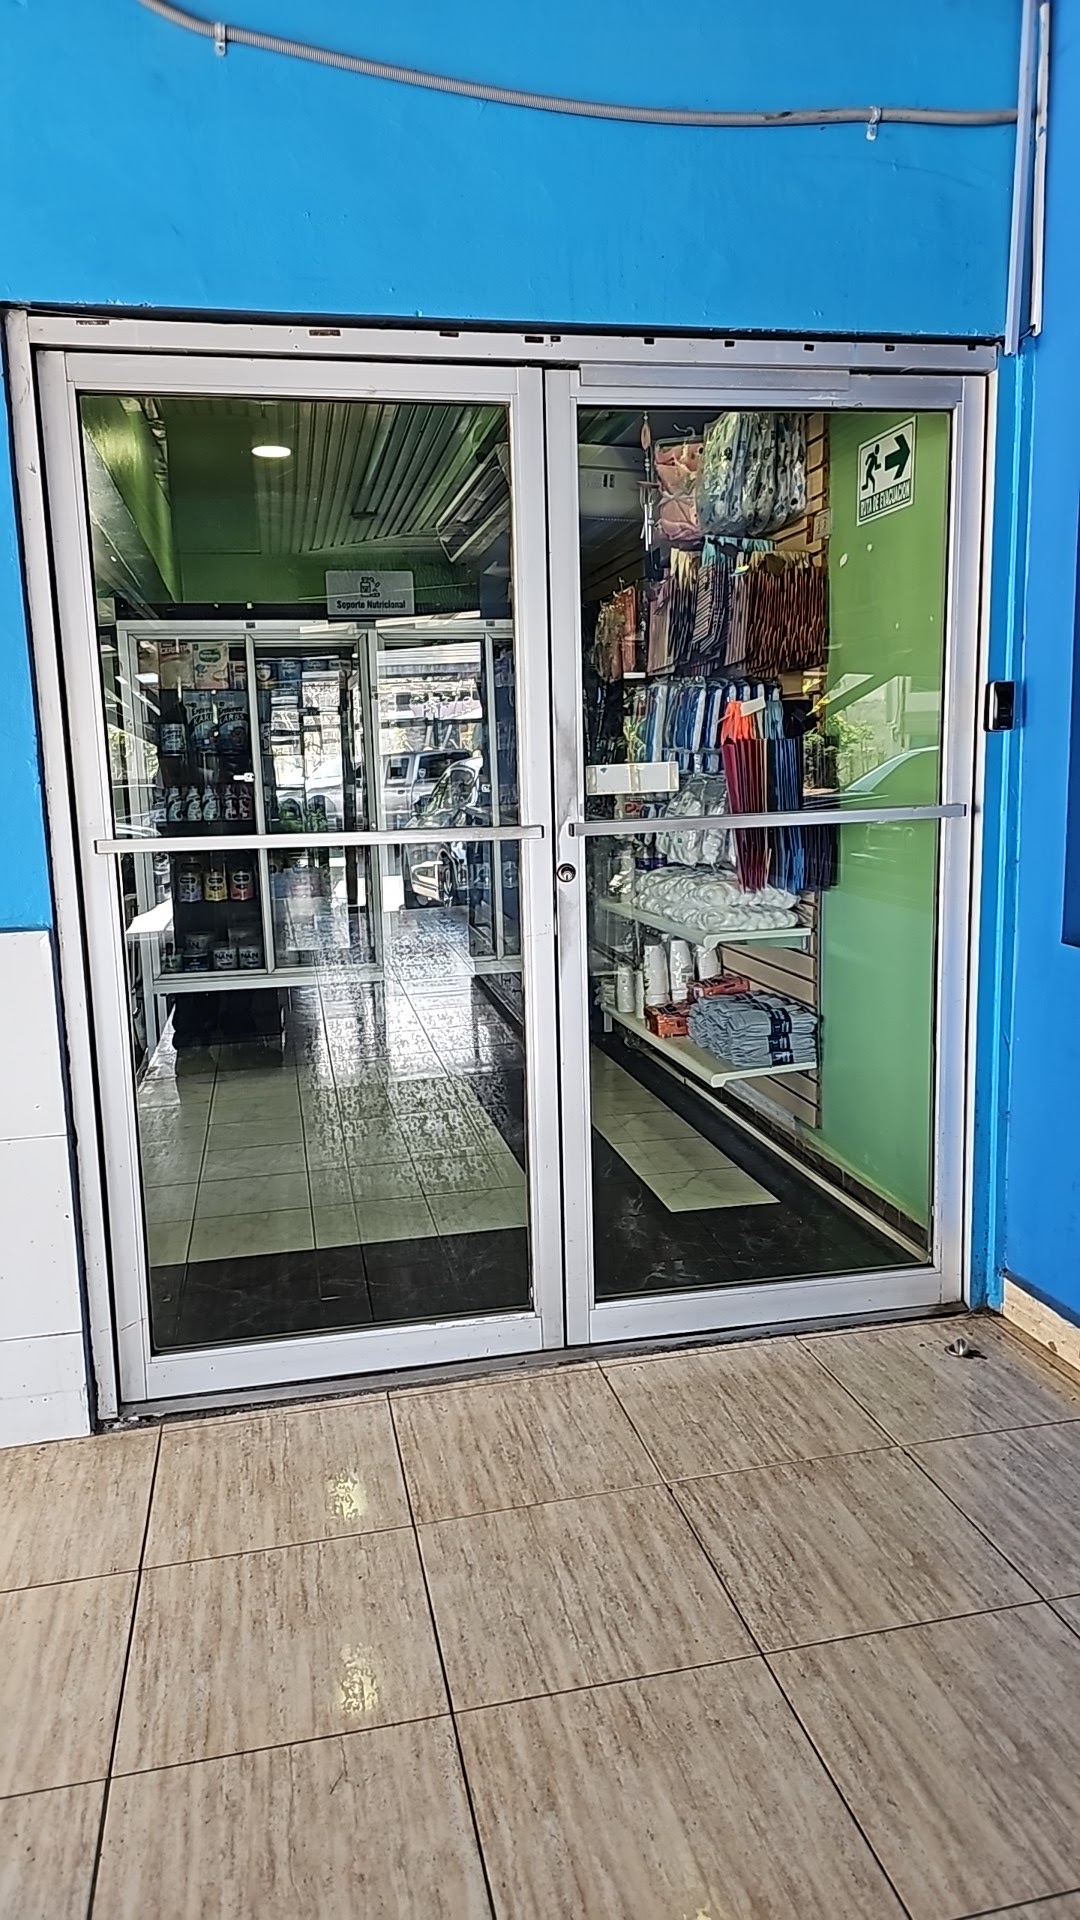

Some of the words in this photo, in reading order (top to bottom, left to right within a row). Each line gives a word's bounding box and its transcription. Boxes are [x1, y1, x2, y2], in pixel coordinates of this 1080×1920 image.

[860, 497, 873, 517] RUTA
[336, 600, 366, 610] Soporte
[367, 600, 406, 609] Nutricional
